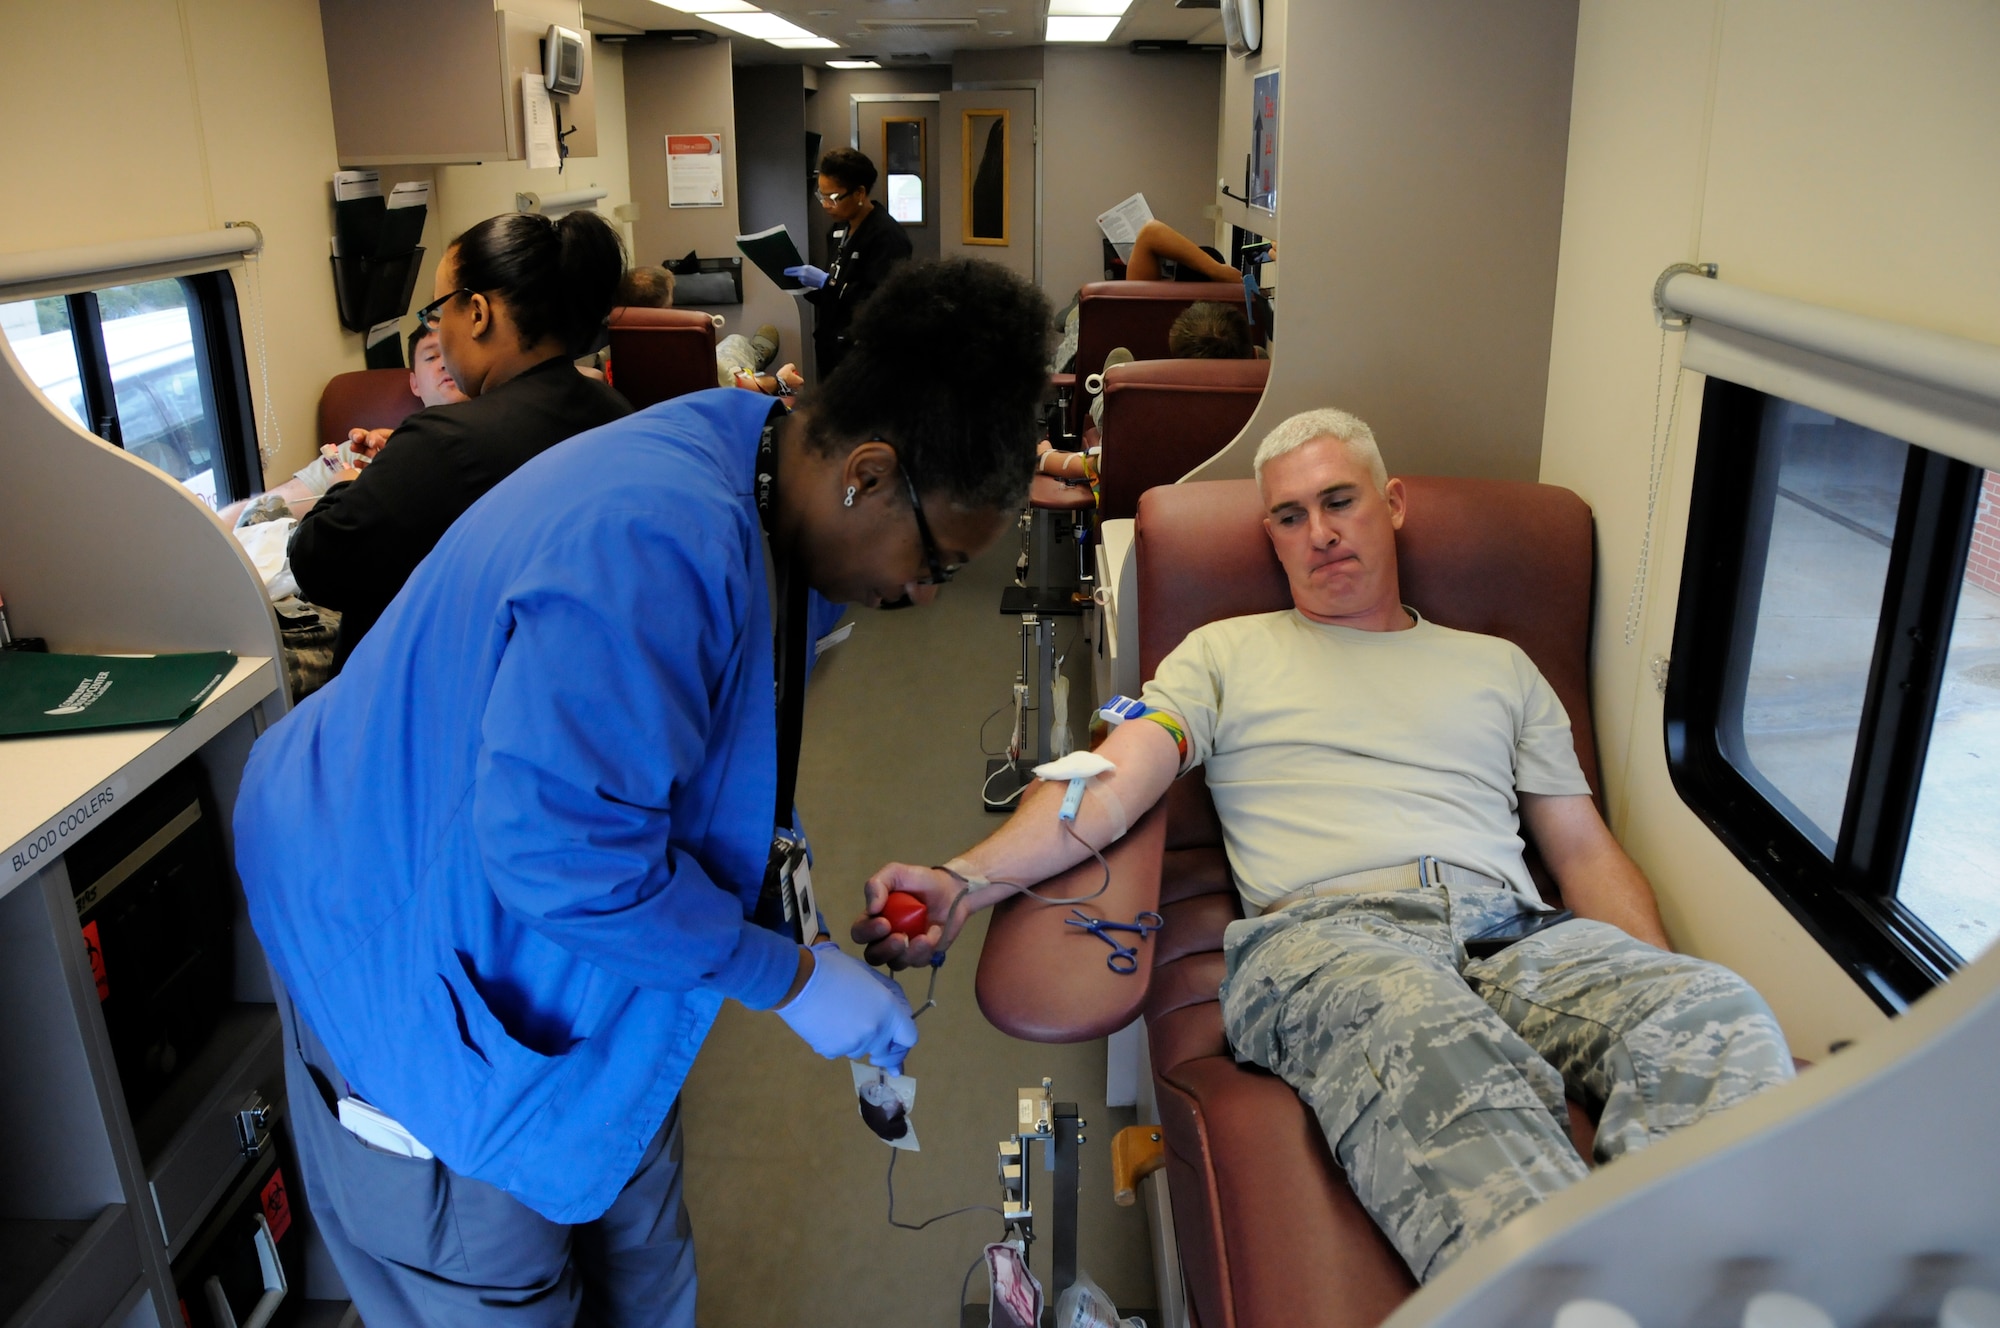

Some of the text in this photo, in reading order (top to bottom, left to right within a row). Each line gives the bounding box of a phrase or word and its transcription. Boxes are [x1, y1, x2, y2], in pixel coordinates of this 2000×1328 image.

[760, 483, 769, 509] CBCC
[12, 787, 114, 872] BLOOD COOLERS
